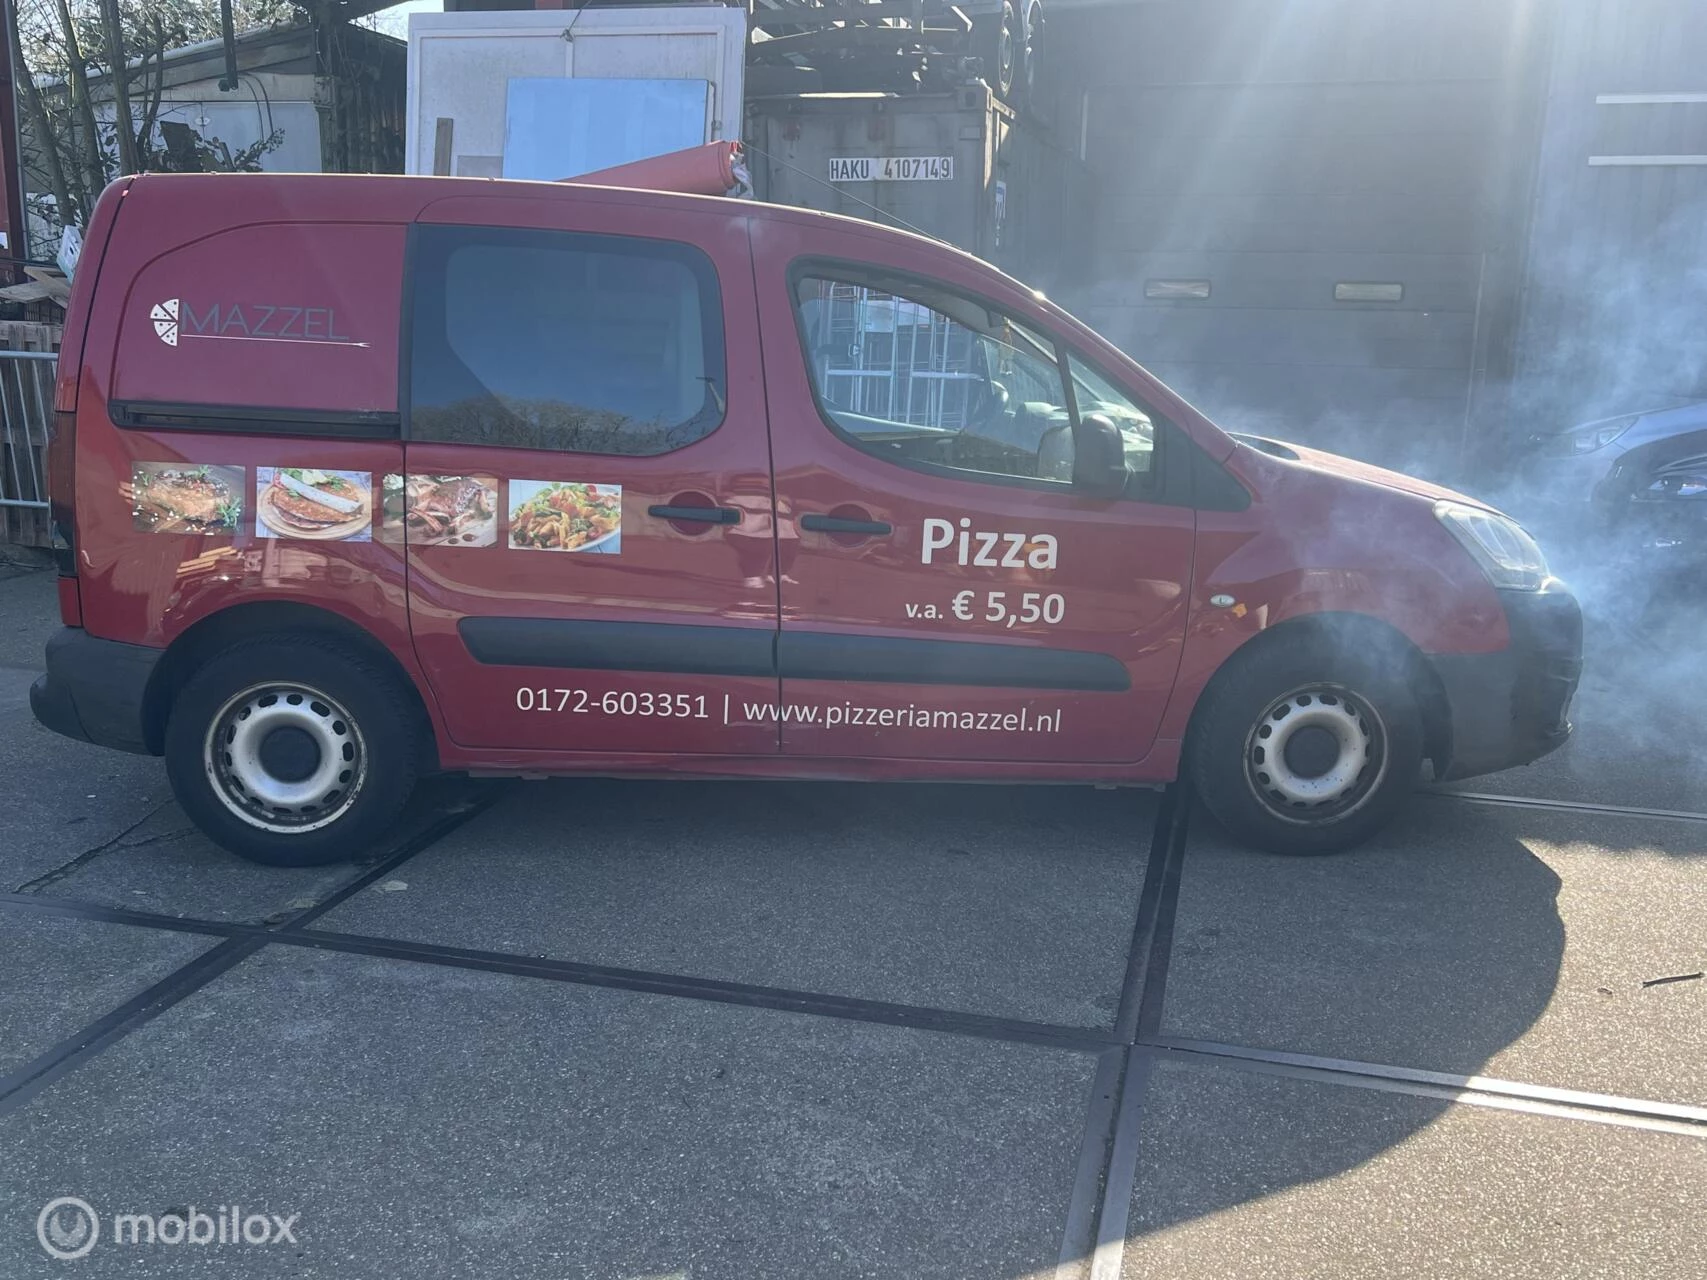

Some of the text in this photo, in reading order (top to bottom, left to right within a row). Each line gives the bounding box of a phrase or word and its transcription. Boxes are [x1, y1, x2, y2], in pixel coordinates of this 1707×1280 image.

[831, 158, 950, 179] HAKU 4107149
[180, 301, 350, 340] MAZZEL
[921, 517, 1058, 570] Pizza
[905, 590, 1065, 629] v.a. € 5,50
[516, 687, 709, 719] 0172-603351
[743, 701, 1062, 733] www.pizzeriamazzel.nl
